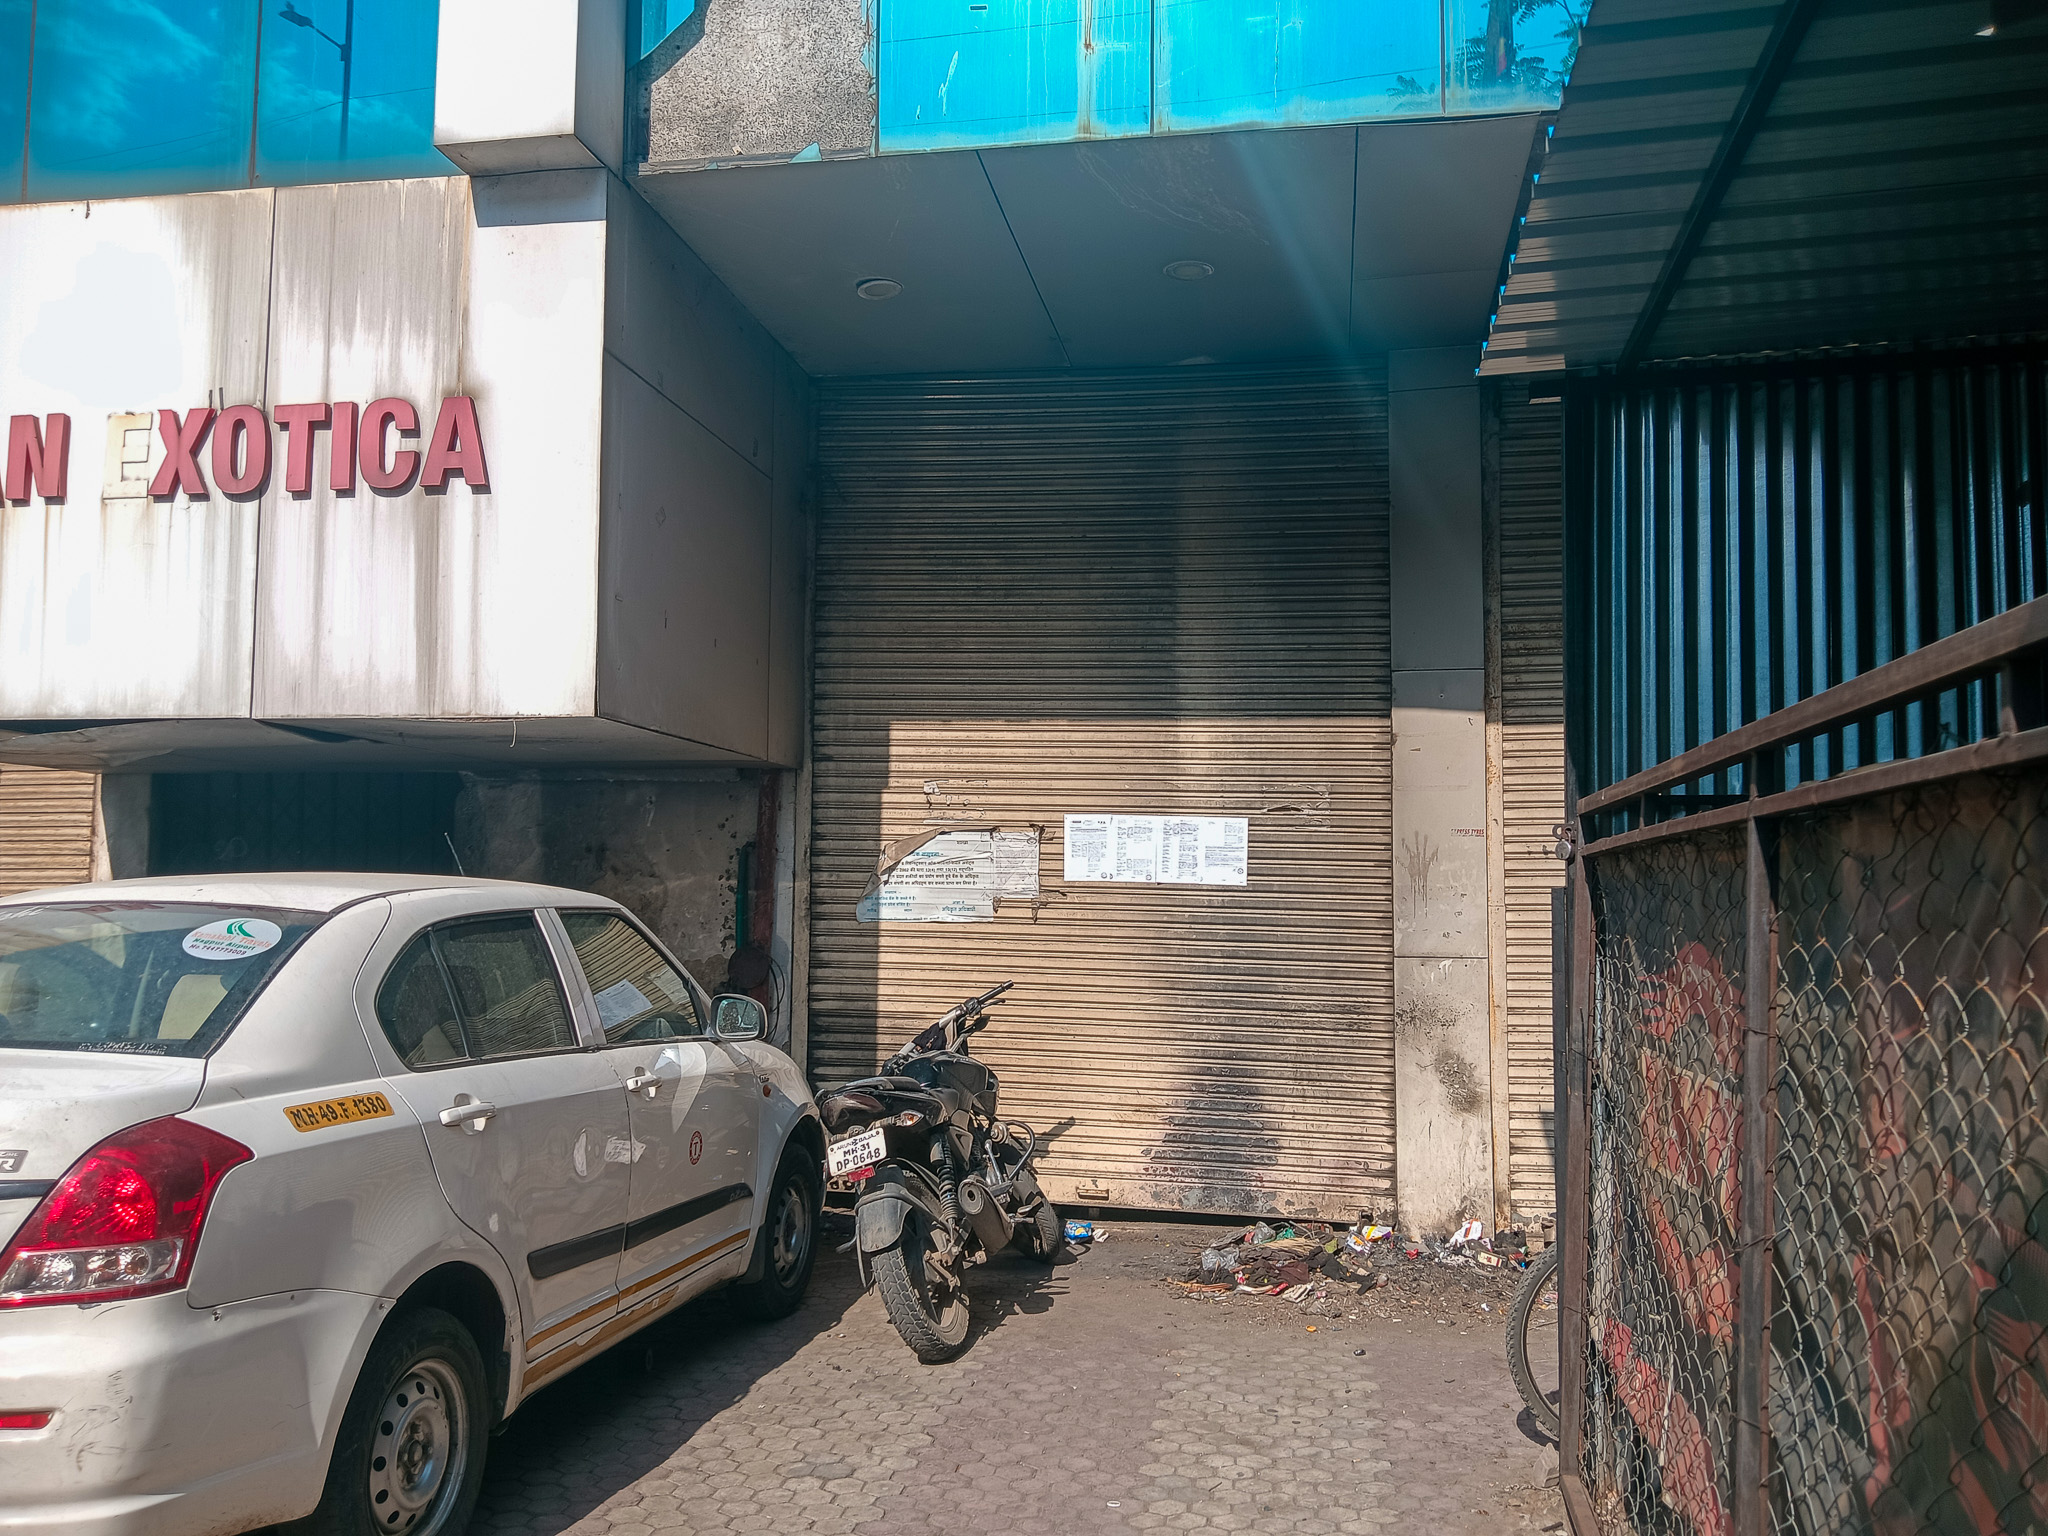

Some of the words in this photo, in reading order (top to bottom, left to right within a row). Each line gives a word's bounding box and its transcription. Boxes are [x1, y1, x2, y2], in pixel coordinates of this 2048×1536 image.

[0, 412, 71, 506] N
[103, 396, 491, 500] EXOTICA
[225, 942, 256, 951] Airport
